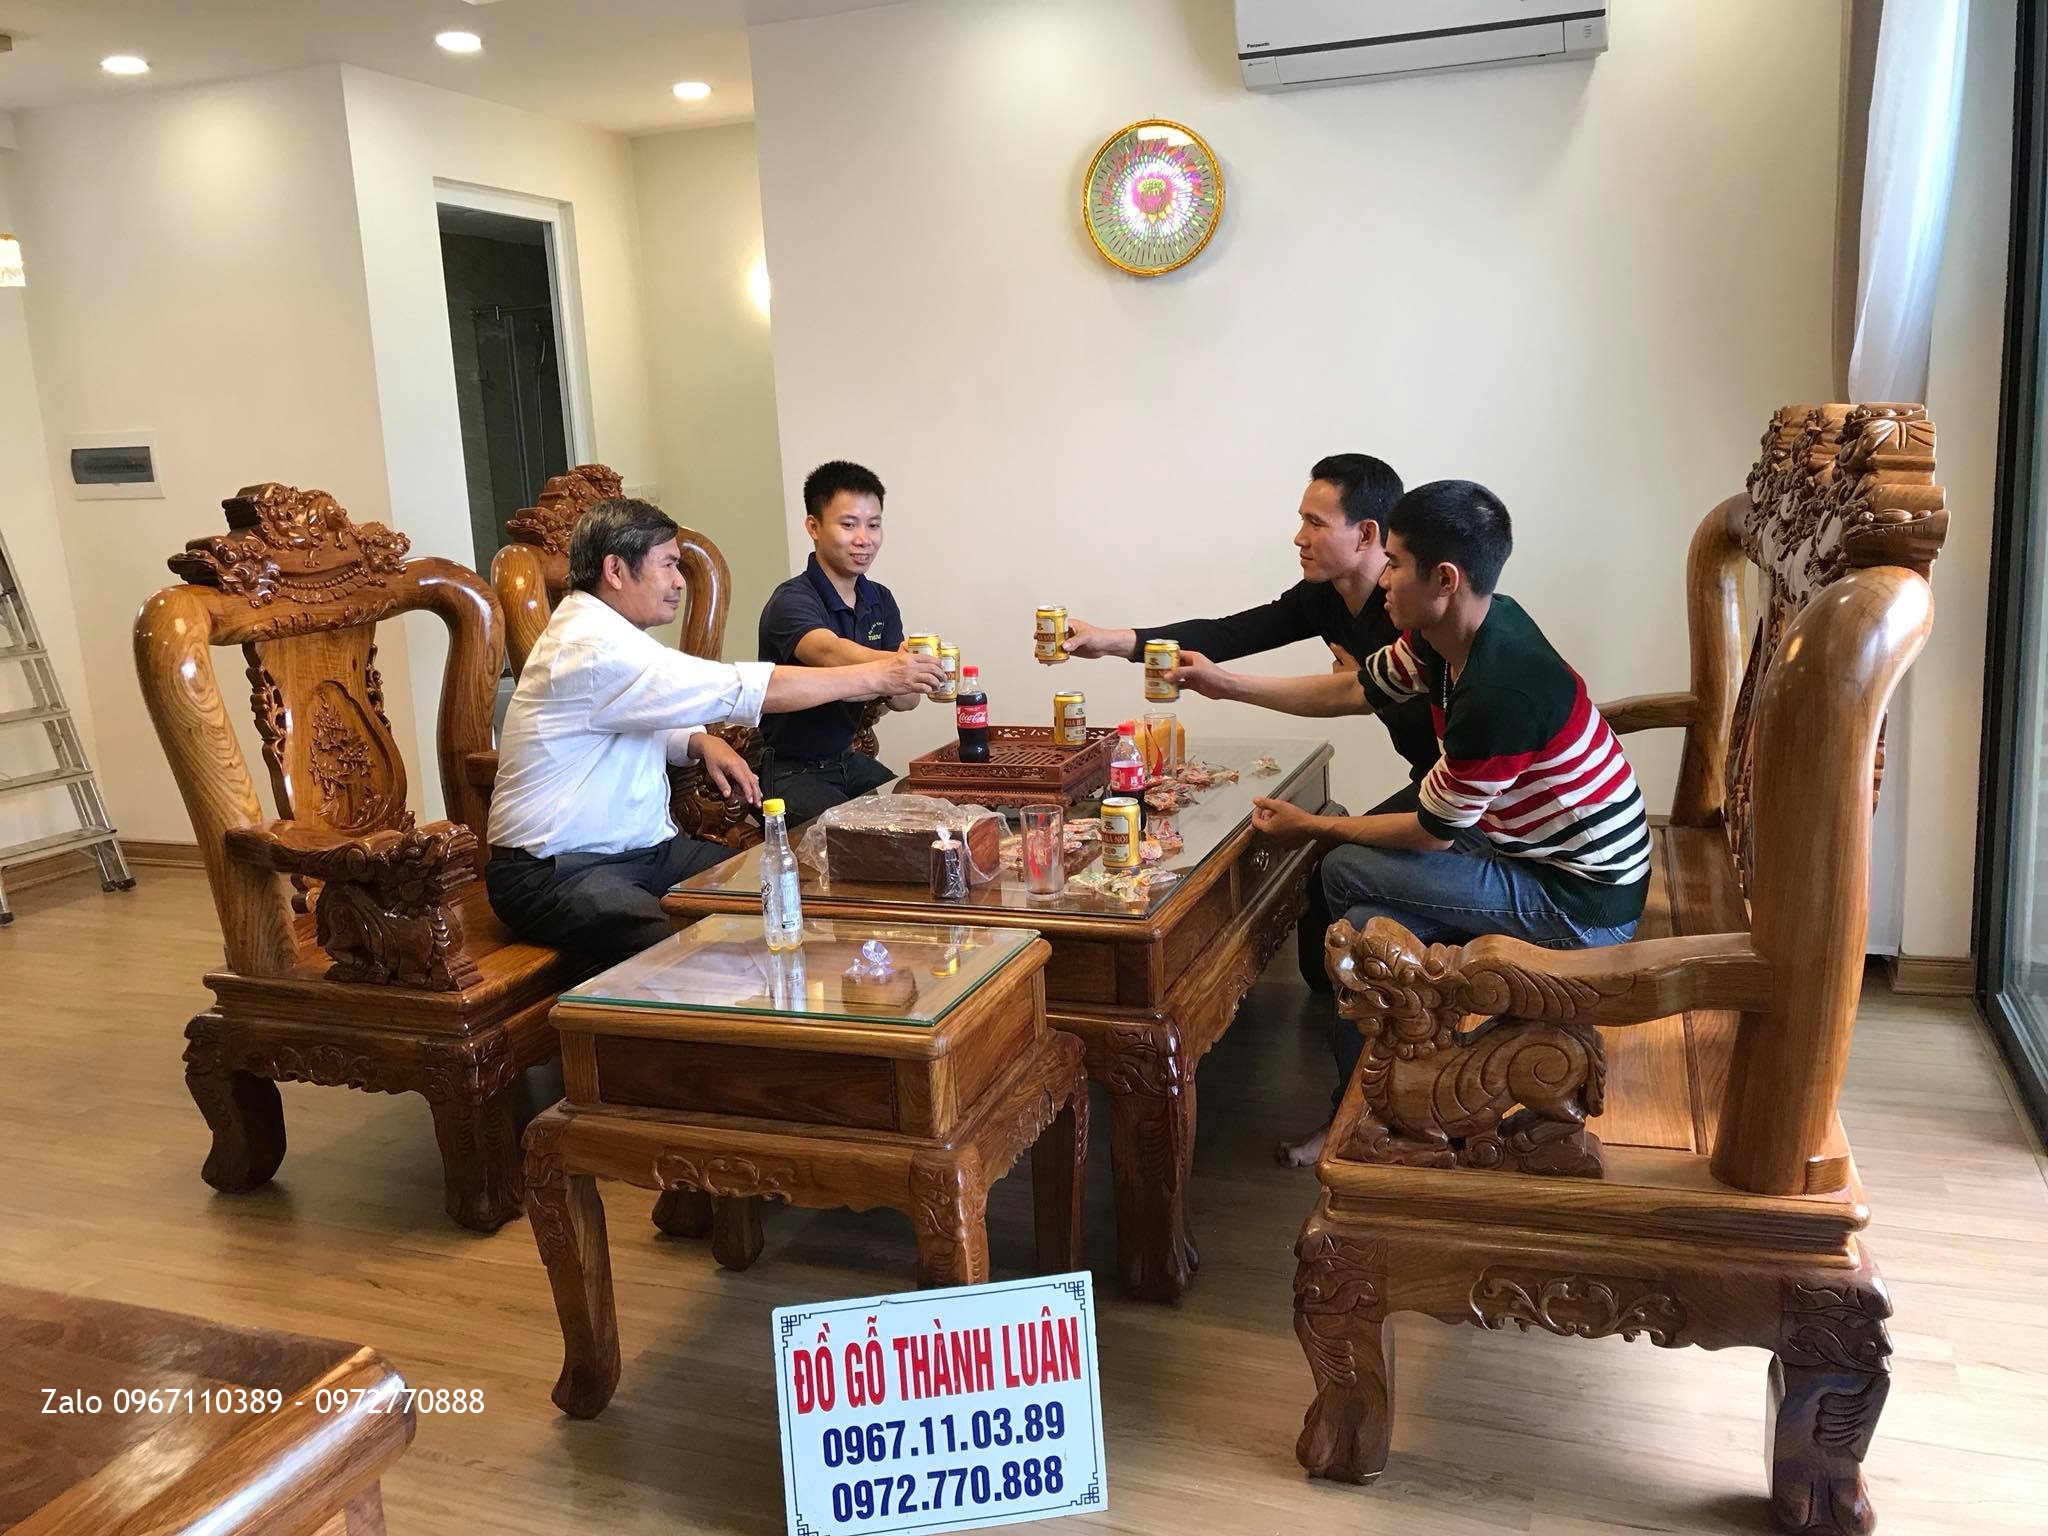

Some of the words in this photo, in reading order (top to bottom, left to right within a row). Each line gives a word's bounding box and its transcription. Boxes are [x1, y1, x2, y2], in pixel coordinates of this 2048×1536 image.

[793, 1323, 836, 1415] ĐỒ
[844, 1315, 886, 1408] GỖ
[892, 1318, 995, 1401] THÀNH
[1001, 1305, 1082, 1389] LUÂN
[822, 1401, 1065, 1468] 0967.11.03.89
[832, 1455, 1064, 1523] 0972.770.888
